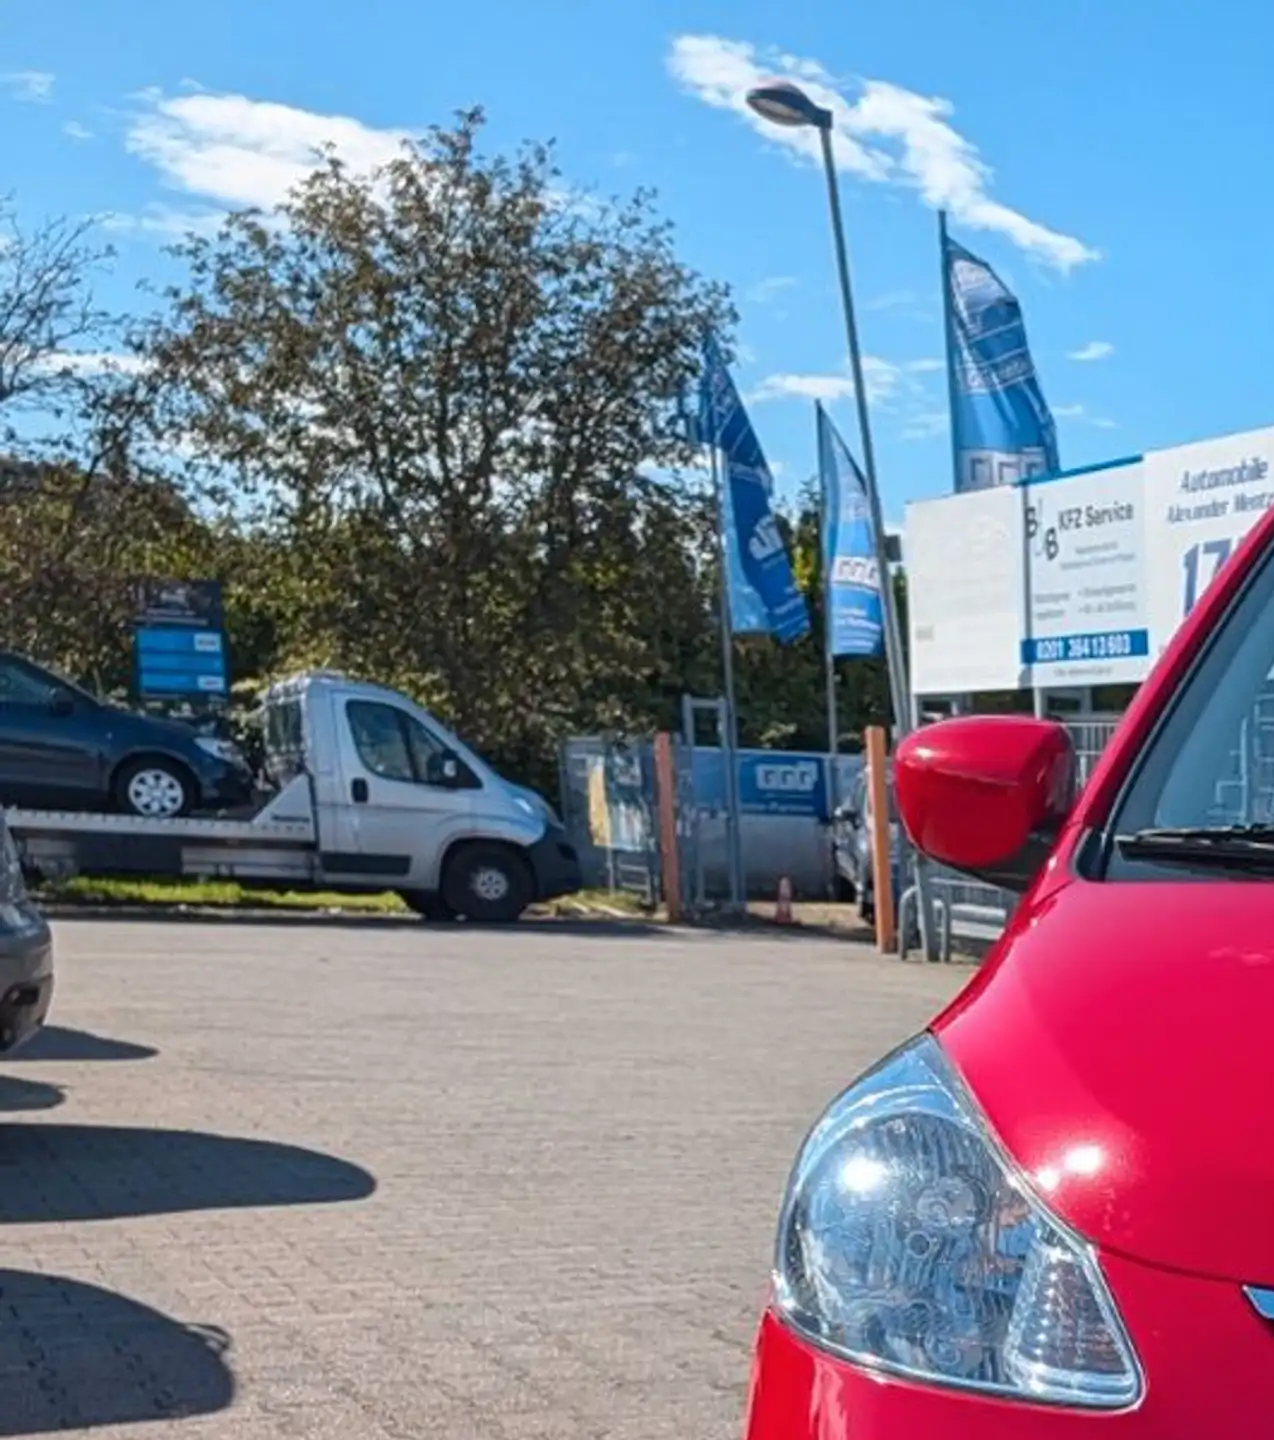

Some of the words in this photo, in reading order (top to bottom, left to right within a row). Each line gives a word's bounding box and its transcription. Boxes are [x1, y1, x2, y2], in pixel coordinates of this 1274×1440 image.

[1181, 457, 1269, 492] Automobile
[1058, 507, 1083, 531] KFZ
[1085, 500, 1135, 528] Service
[1182, 537, 1246, 617] 17
